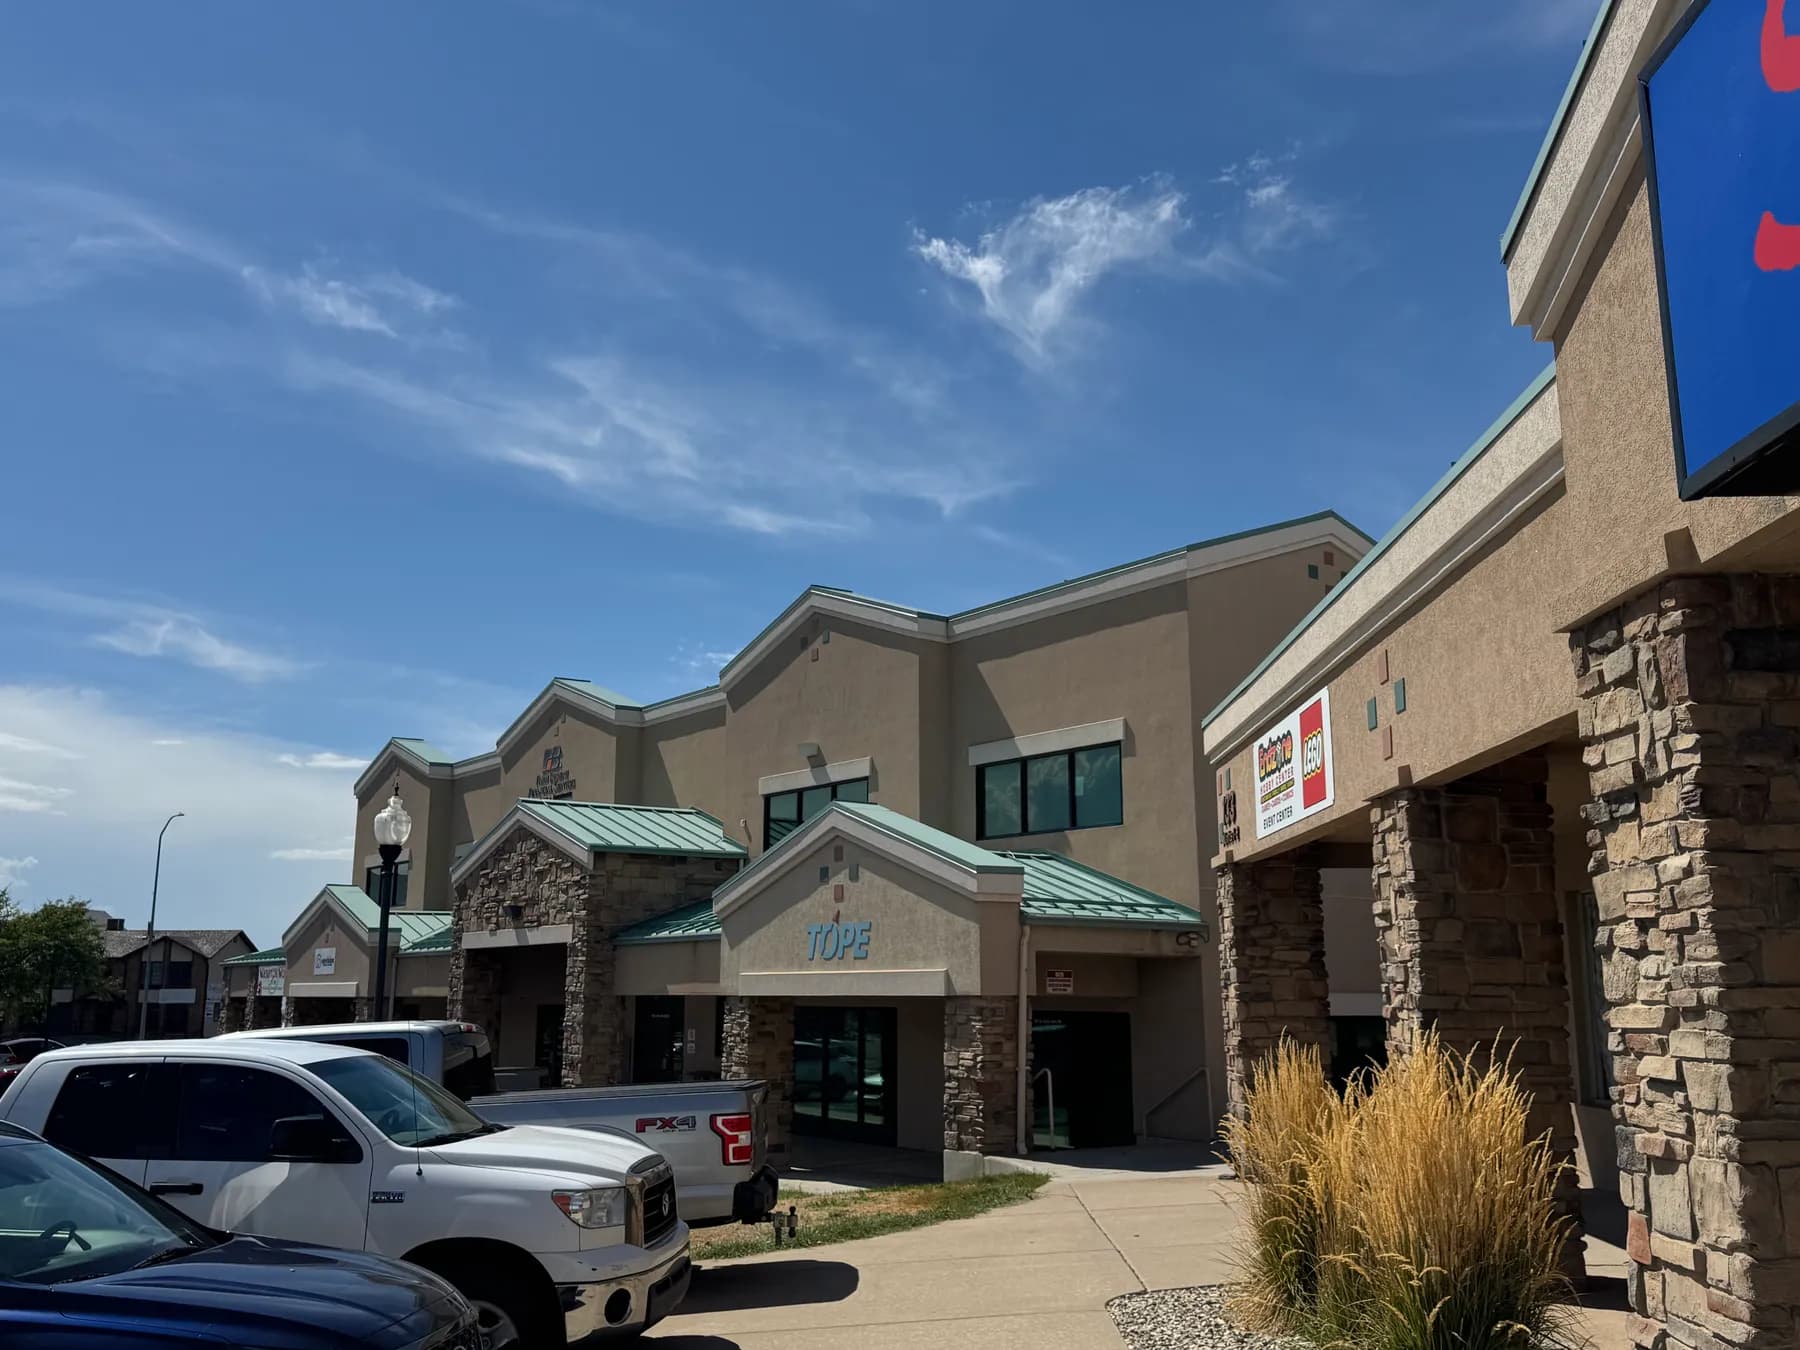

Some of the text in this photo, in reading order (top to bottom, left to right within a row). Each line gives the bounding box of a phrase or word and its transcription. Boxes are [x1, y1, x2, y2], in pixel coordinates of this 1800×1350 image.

[1303, 730, 1322, 778] LEGO
[1275, 766, 1293, 786] CENTER
[1263, 813, 1276, 829] EVENT
[1276, 805, 1292, 823] CENTER
[807, 920, 872, 961] TOPE
[636, 1115, 696, 1133] FX4
